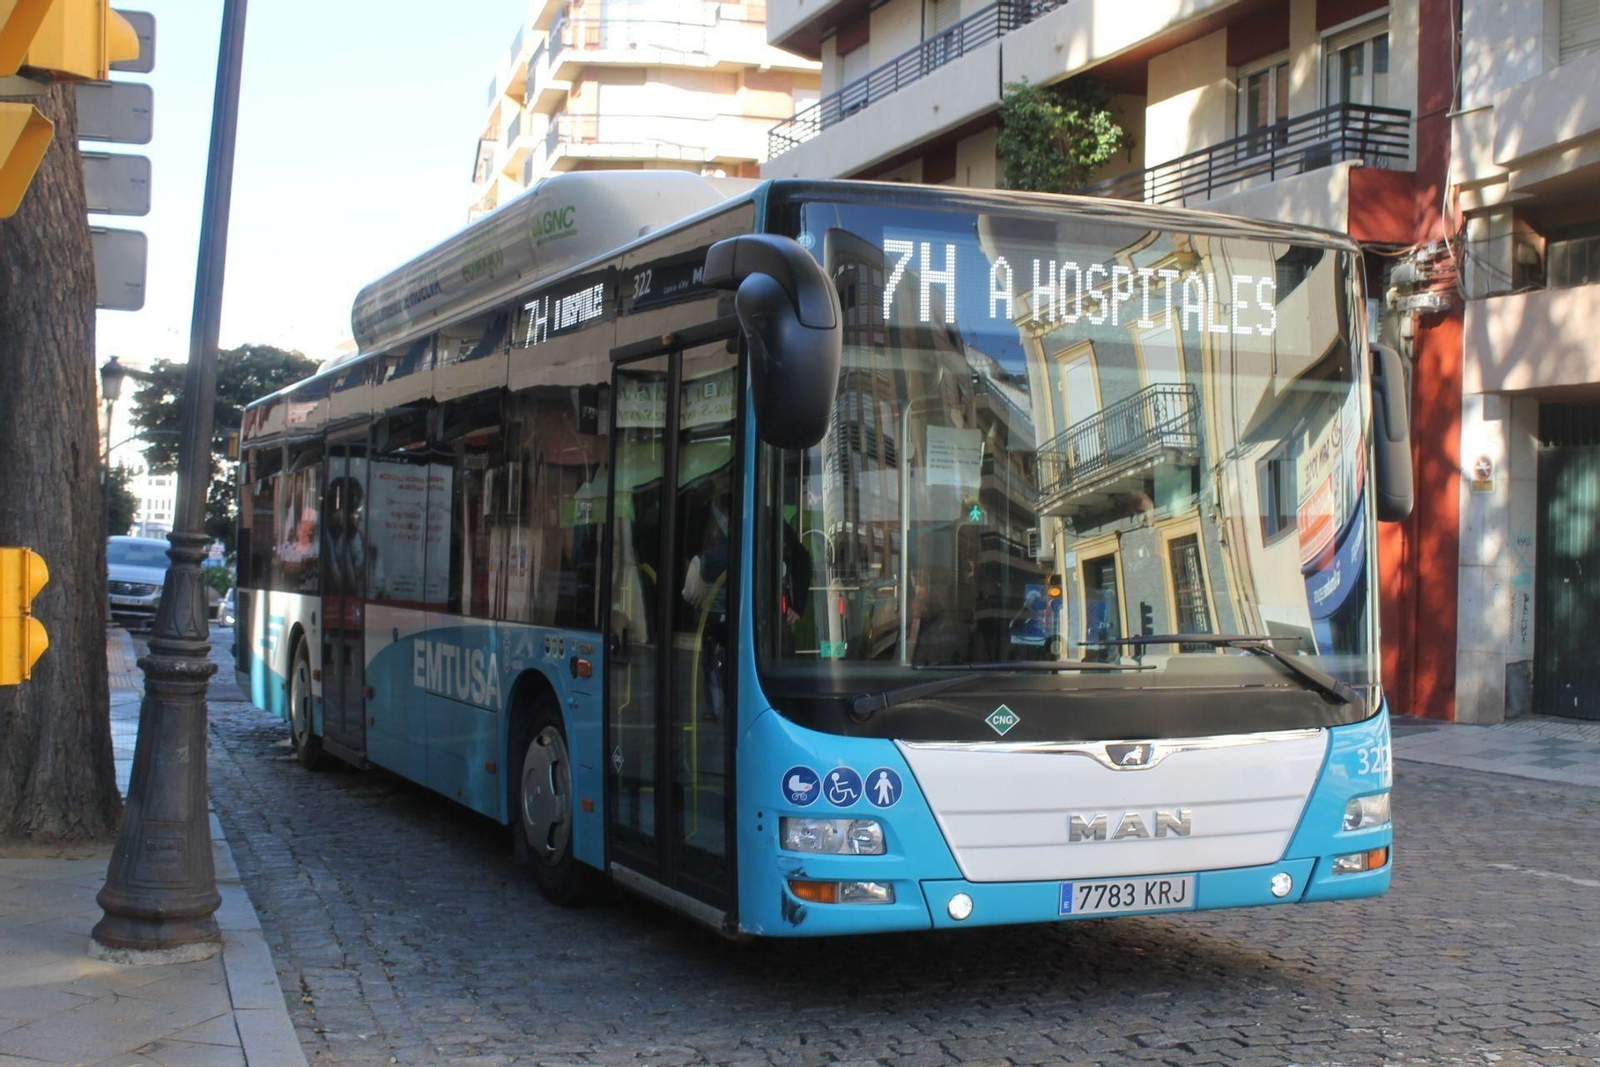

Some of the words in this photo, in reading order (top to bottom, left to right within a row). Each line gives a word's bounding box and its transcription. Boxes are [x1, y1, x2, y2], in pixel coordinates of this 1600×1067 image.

[543, 204, 576, 235] GNC
[632, 269, 652, 299] 322
[883, 239, 955, 323] 7H
[989, 256, 1013, 319] A
[1033, 258, 1277, 335] HOSPITALES
[524, 296, 549, 349] 7H
[413, 638, 502, 709] EMTUSA
[992, 715, 1013, 726] CNG
[1069, 808, 1192, 842] MAN
[1080, 883, 1135, 910] 7783
[1145, 879, 1186, 905] KRJ
